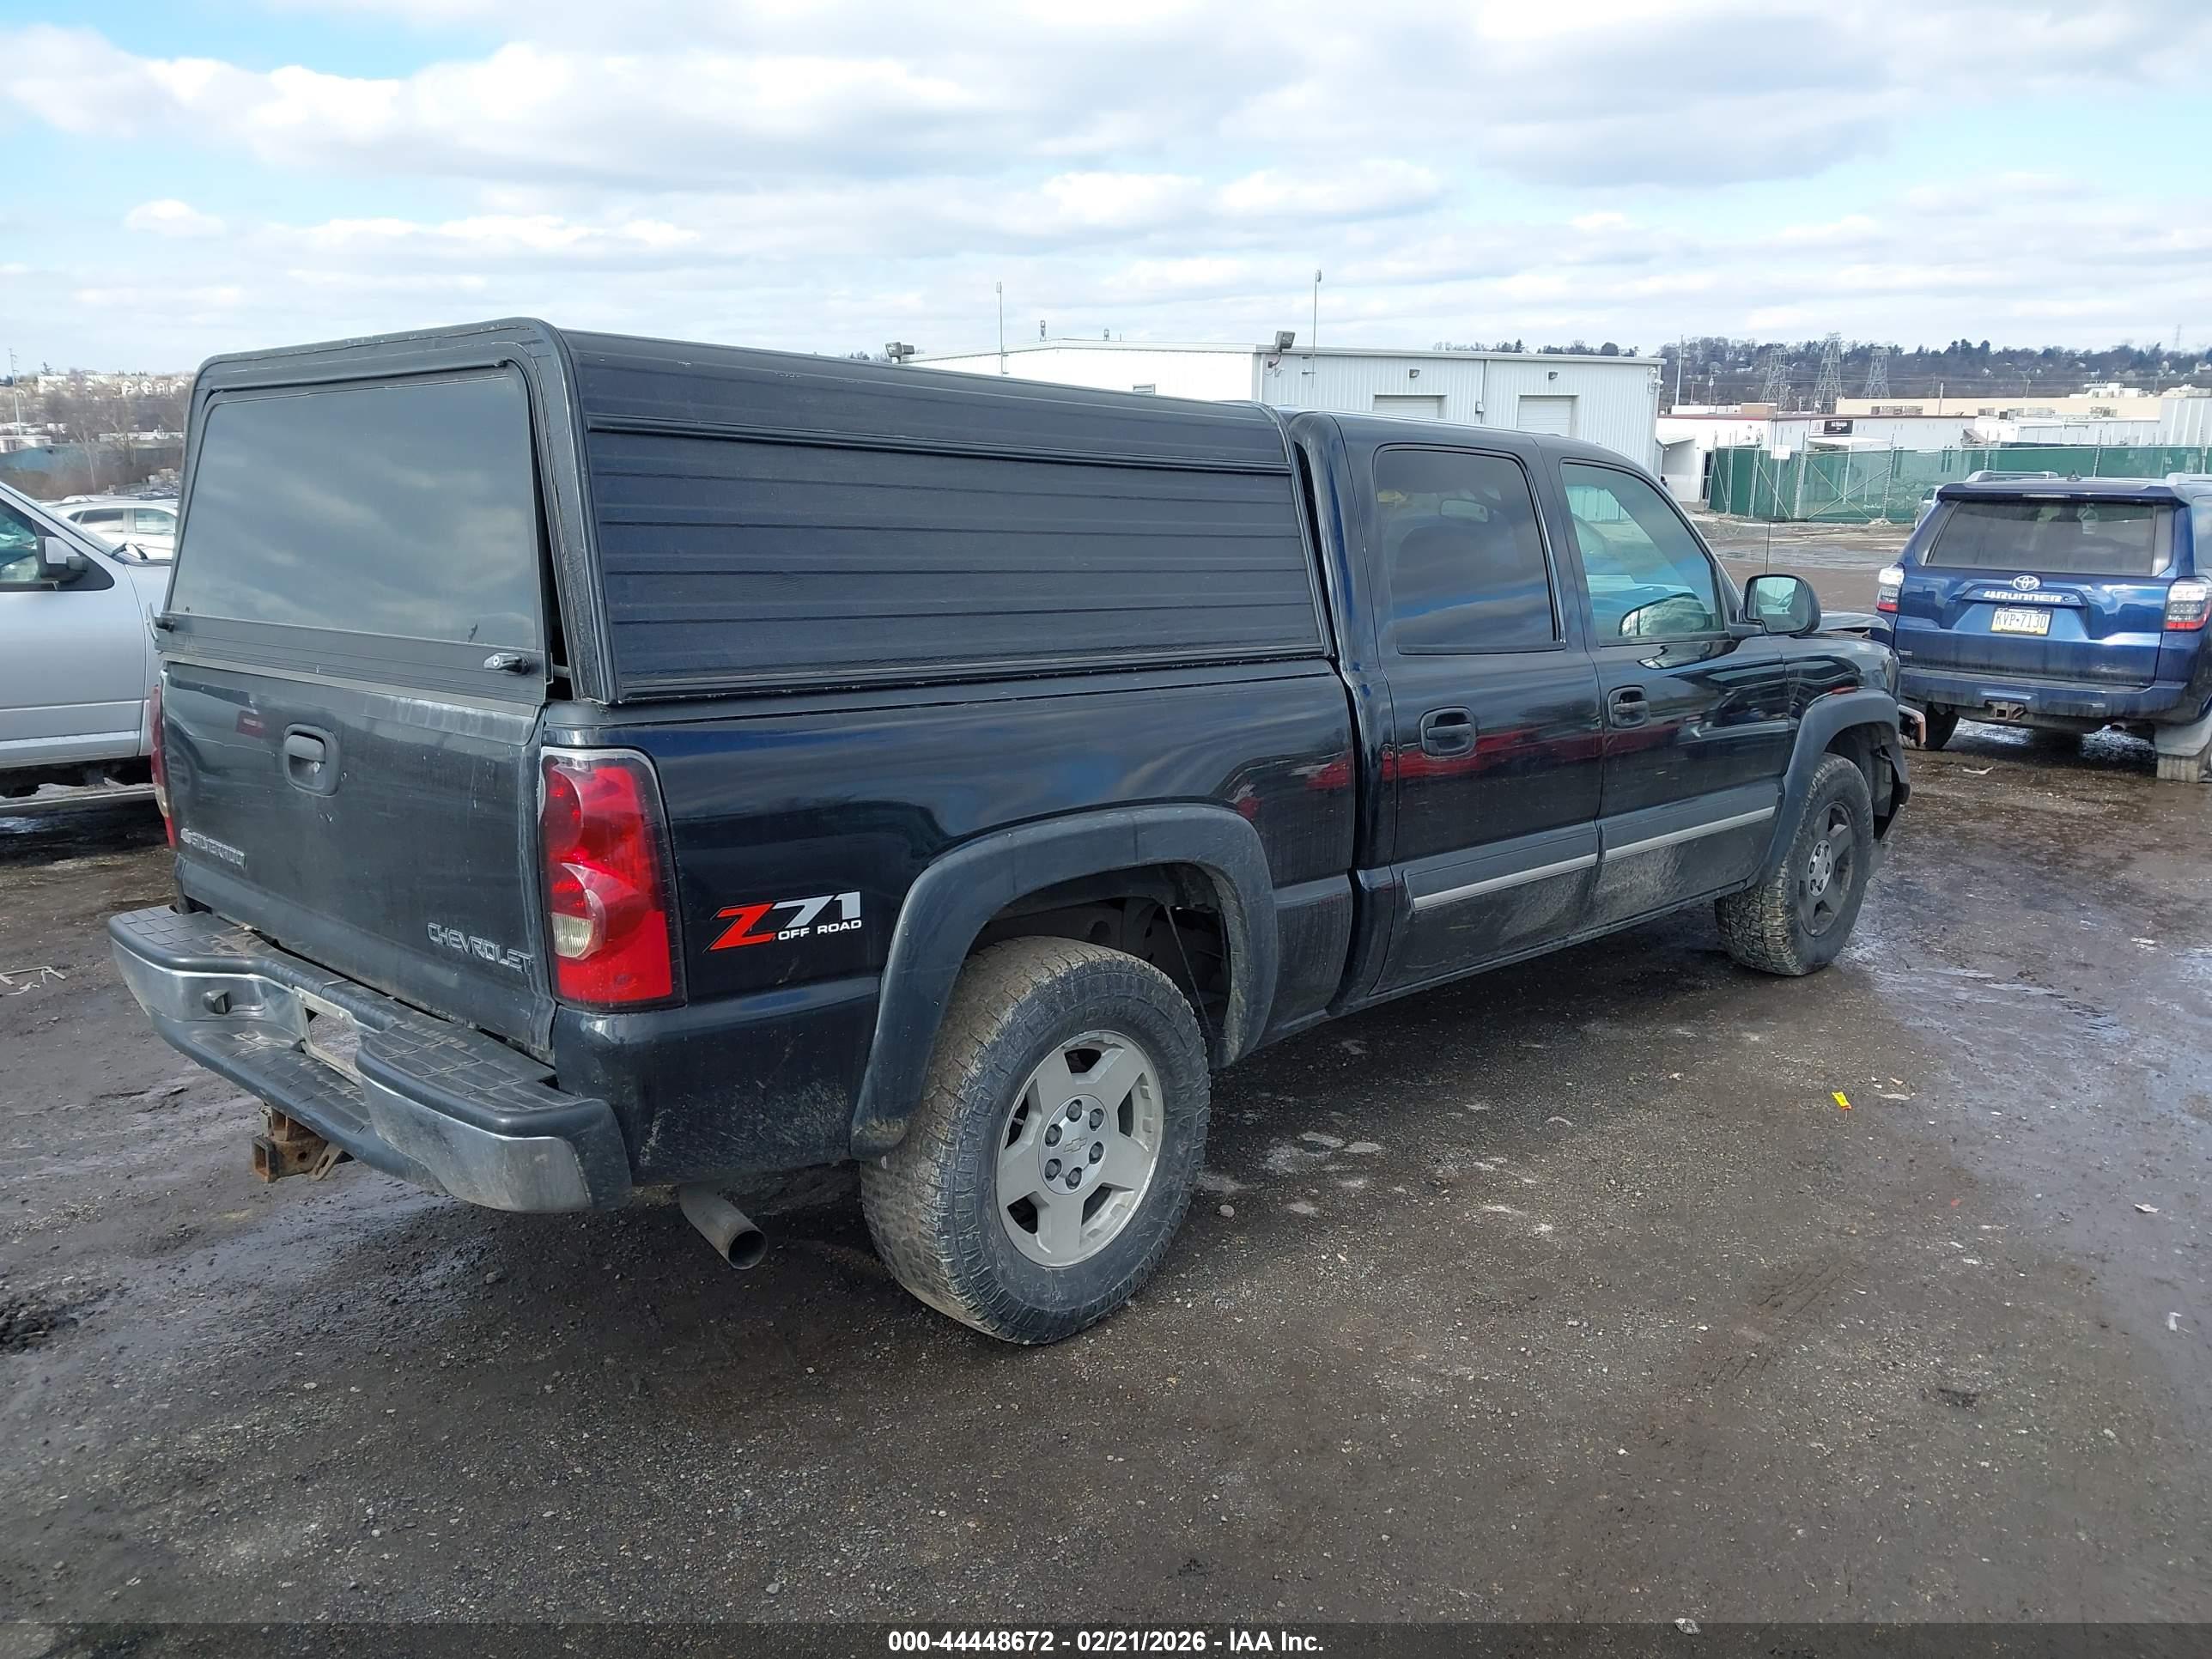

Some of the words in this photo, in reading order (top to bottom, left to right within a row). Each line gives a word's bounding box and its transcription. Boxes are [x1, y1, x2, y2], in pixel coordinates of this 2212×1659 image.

[704, 890, 861, 952] Z71
[777, 927, 811, 941] OFF
[817, 920, 862, 935] ROAD
[427, 922, 533, 975] CHEVROLET
